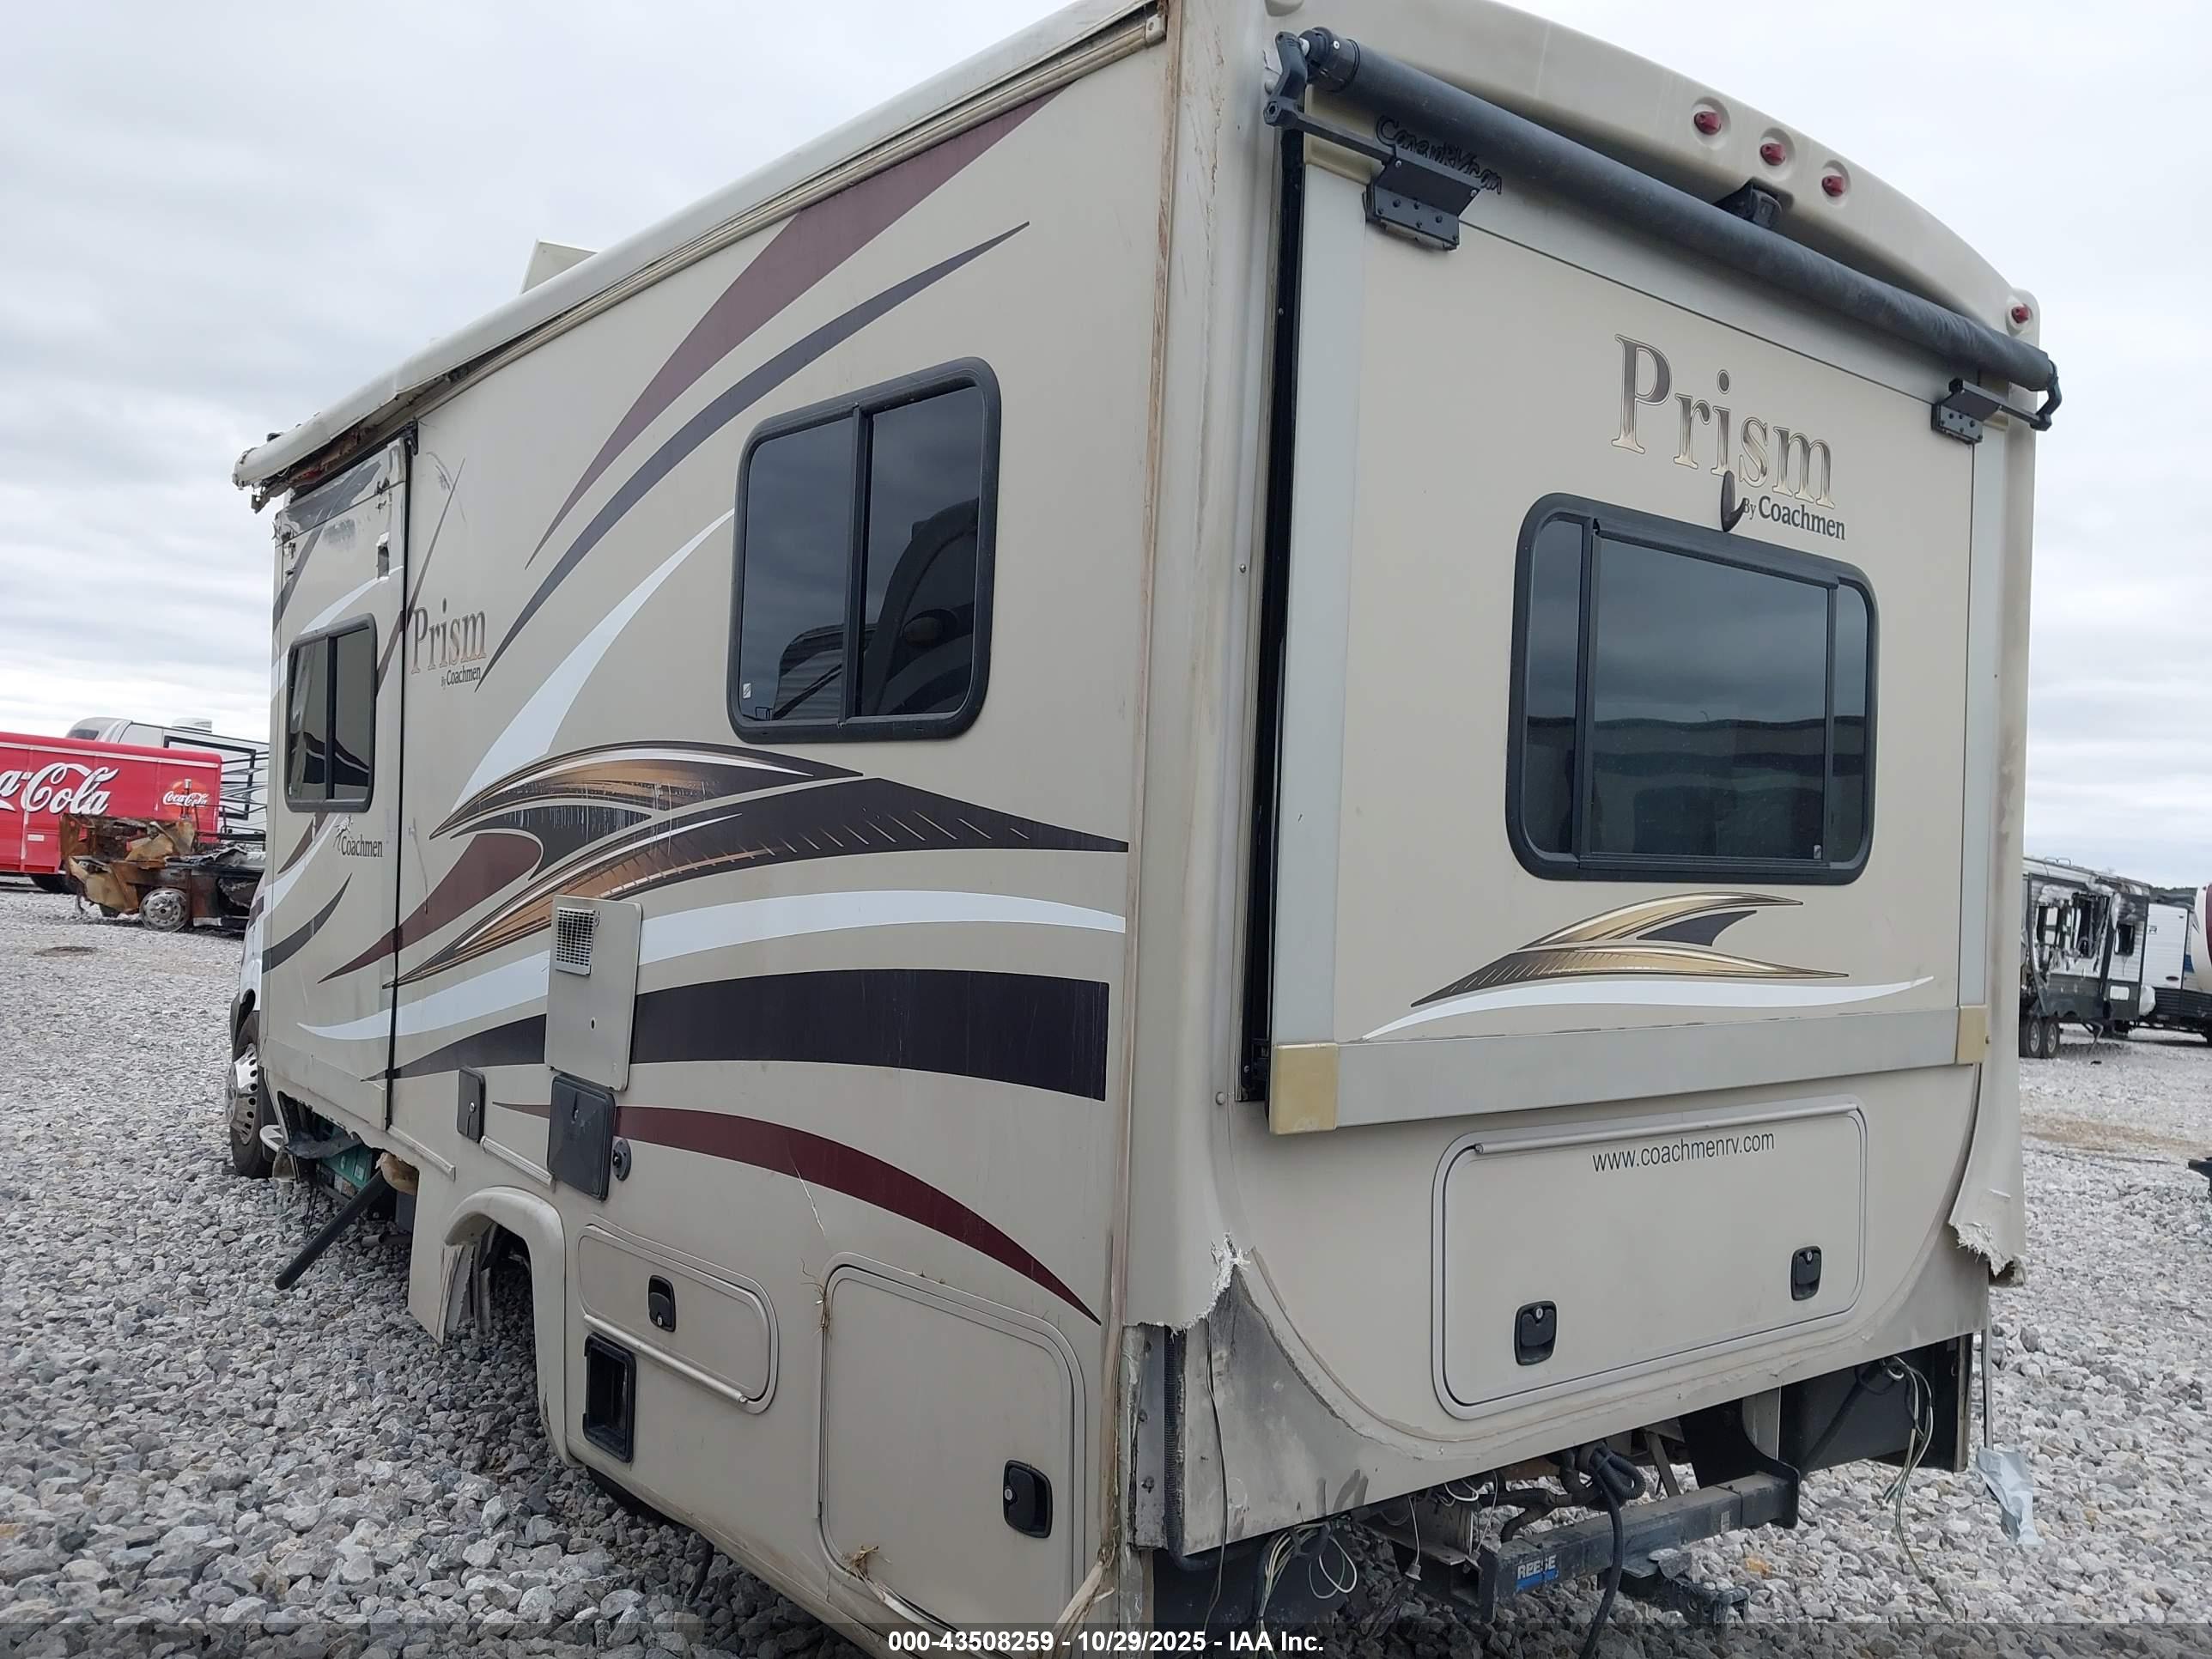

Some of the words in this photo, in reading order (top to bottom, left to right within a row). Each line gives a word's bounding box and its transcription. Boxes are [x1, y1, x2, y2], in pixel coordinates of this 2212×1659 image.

[1611, 334, 1835, 509] Prism
[1743, 498, 1757, 520] By
[1758, 495, 1845, 540] Coachmen
[410, 598, 487, 674] Prism
[447, 665, 481, 686] Coachmen
[0, 763, 119, 815] a-Cola
[341, 833, 383, 858] Coachmen
[1592, 1133, 1775, 1172] www.coachmenrv.com
[1517, 1554, 1557, 1580] REESE
